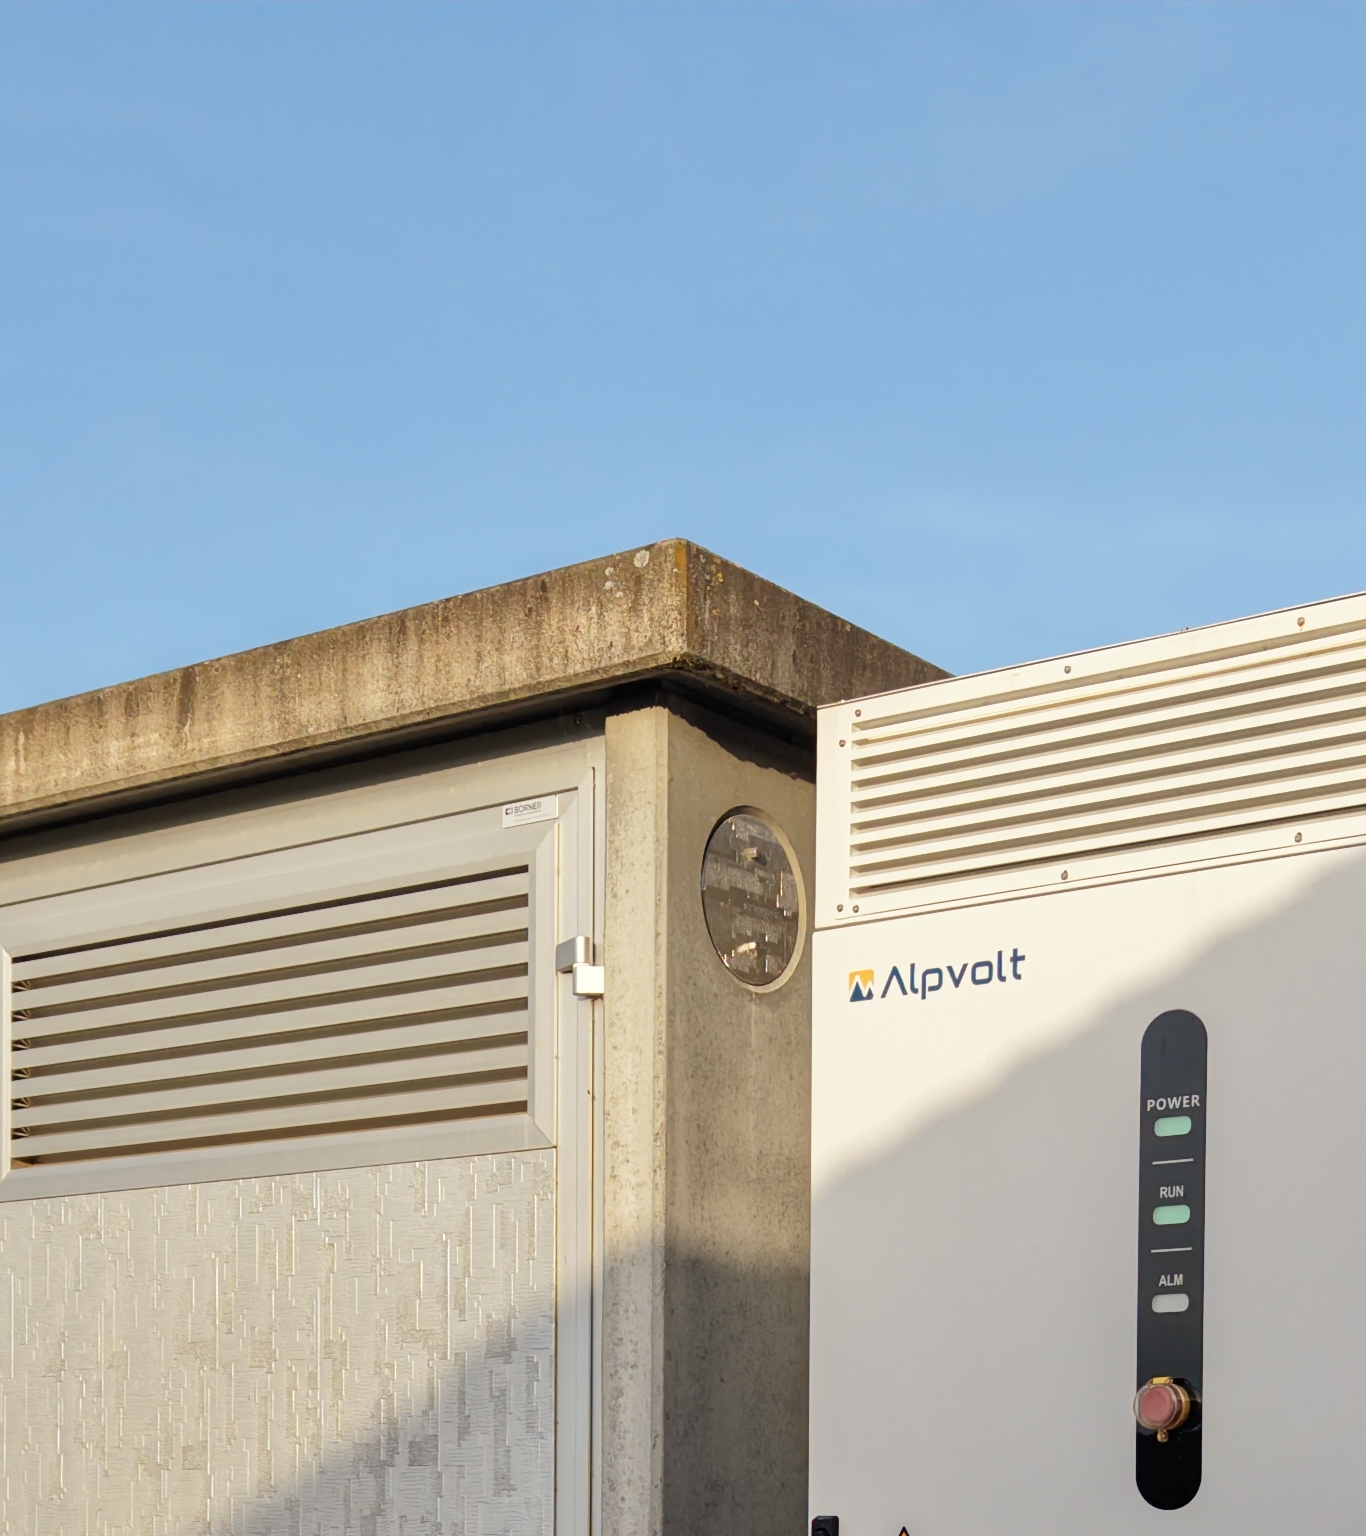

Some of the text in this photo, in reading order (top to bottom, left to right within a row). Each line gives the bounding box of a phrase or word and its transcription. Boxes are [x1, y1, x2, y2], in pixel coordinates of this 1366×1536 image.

[880, 948, 1025, 1000] Alpvolt
[1146, 1094, 1201, 1112] POWER
[1159, 1185, 1185, 1199] RUN
[1158, 1273, 1184, 1287] ALM
